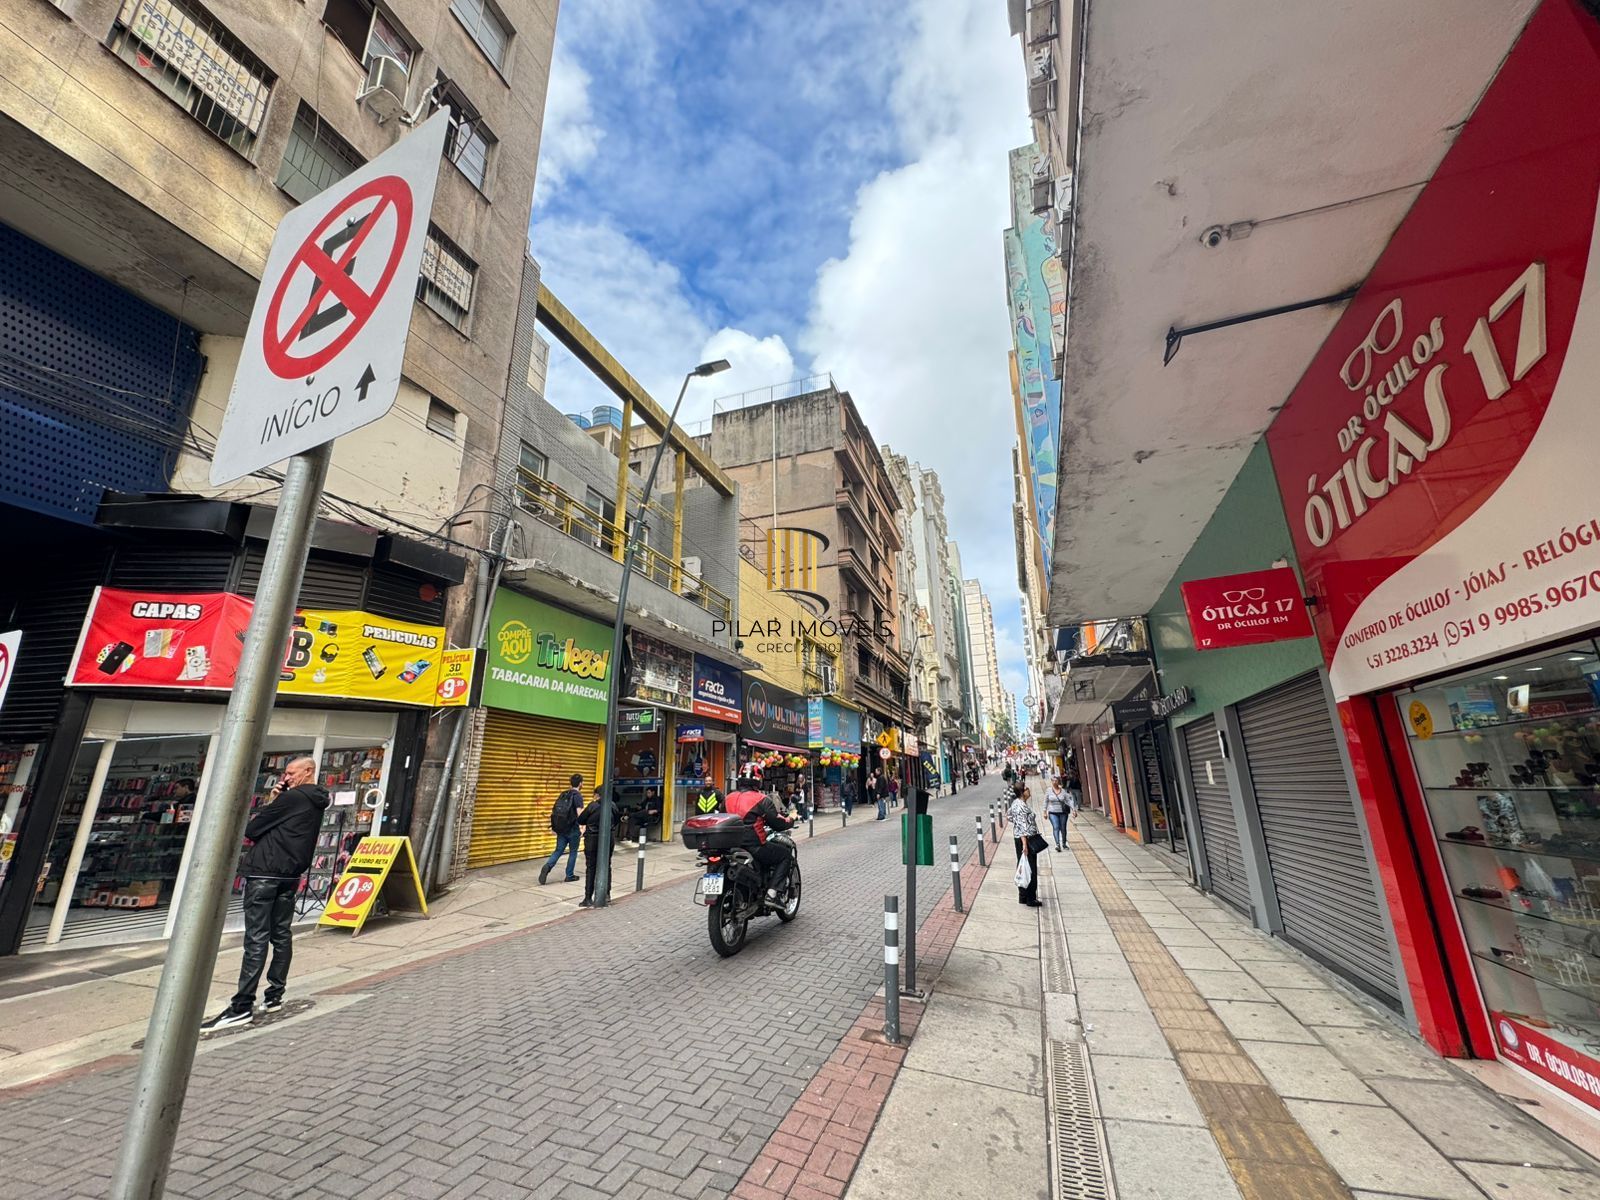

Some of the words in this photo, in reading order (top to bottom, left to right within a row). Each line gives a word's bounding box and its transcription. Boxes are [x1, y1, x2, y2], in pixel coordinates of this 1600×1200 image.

[1337, 416, 1365, 453] DR
[1363, 316, 1444, 421] ÓCULOS
[260, 386, 341, 444] INÍCIO
[1304, 362, 1451, 547] ÓTICAS
[1463, 261, 1547, 401] 17
[131, 601, 202, 620] CAPAS
[1202, 601, 1269, 621] ÓTICAS
[1275, 598, 1293, 612] 17
[1344, 619, 1387, 649] CONSERTO
[1388, 611, 1404, 630] DE
[1405, 588, 1451, 622] ÓCULOS
[1463, 561, 1507, 601] JÓIAS
[1217, 622, 1231, 630] DR
[1234, 617, 1270, 628] ÓCULOS
[1273, 615, 1288, 624] RM
[1372, 654, 1383, 669] 51
[1386, 632, 1439, 664] 3228.3234
[1460, 618, 1476, 638] 51
[1478, 613, 1491, 631] 9
[1494, 570, 1600, 626] 9985.9670
[363, 624, 438, 649] PELICULAS
[498, 628, 532, 641] COMPRE
[1202, 638, 1211, 646] 17
[500, 638, 532, 659] AQUI
[449, 663, 461, 673] 3D
[491, 667, 550, 689] TABACARIA
[551, 679, 564, 692] DA
[565, 683, 608, 701] MARECHAL
[767, 703, 805, 728] MULTIMIX
[357, 841, 396, 855] PELÍCULA
[1525, 1041, 1546, 1068] DR.
